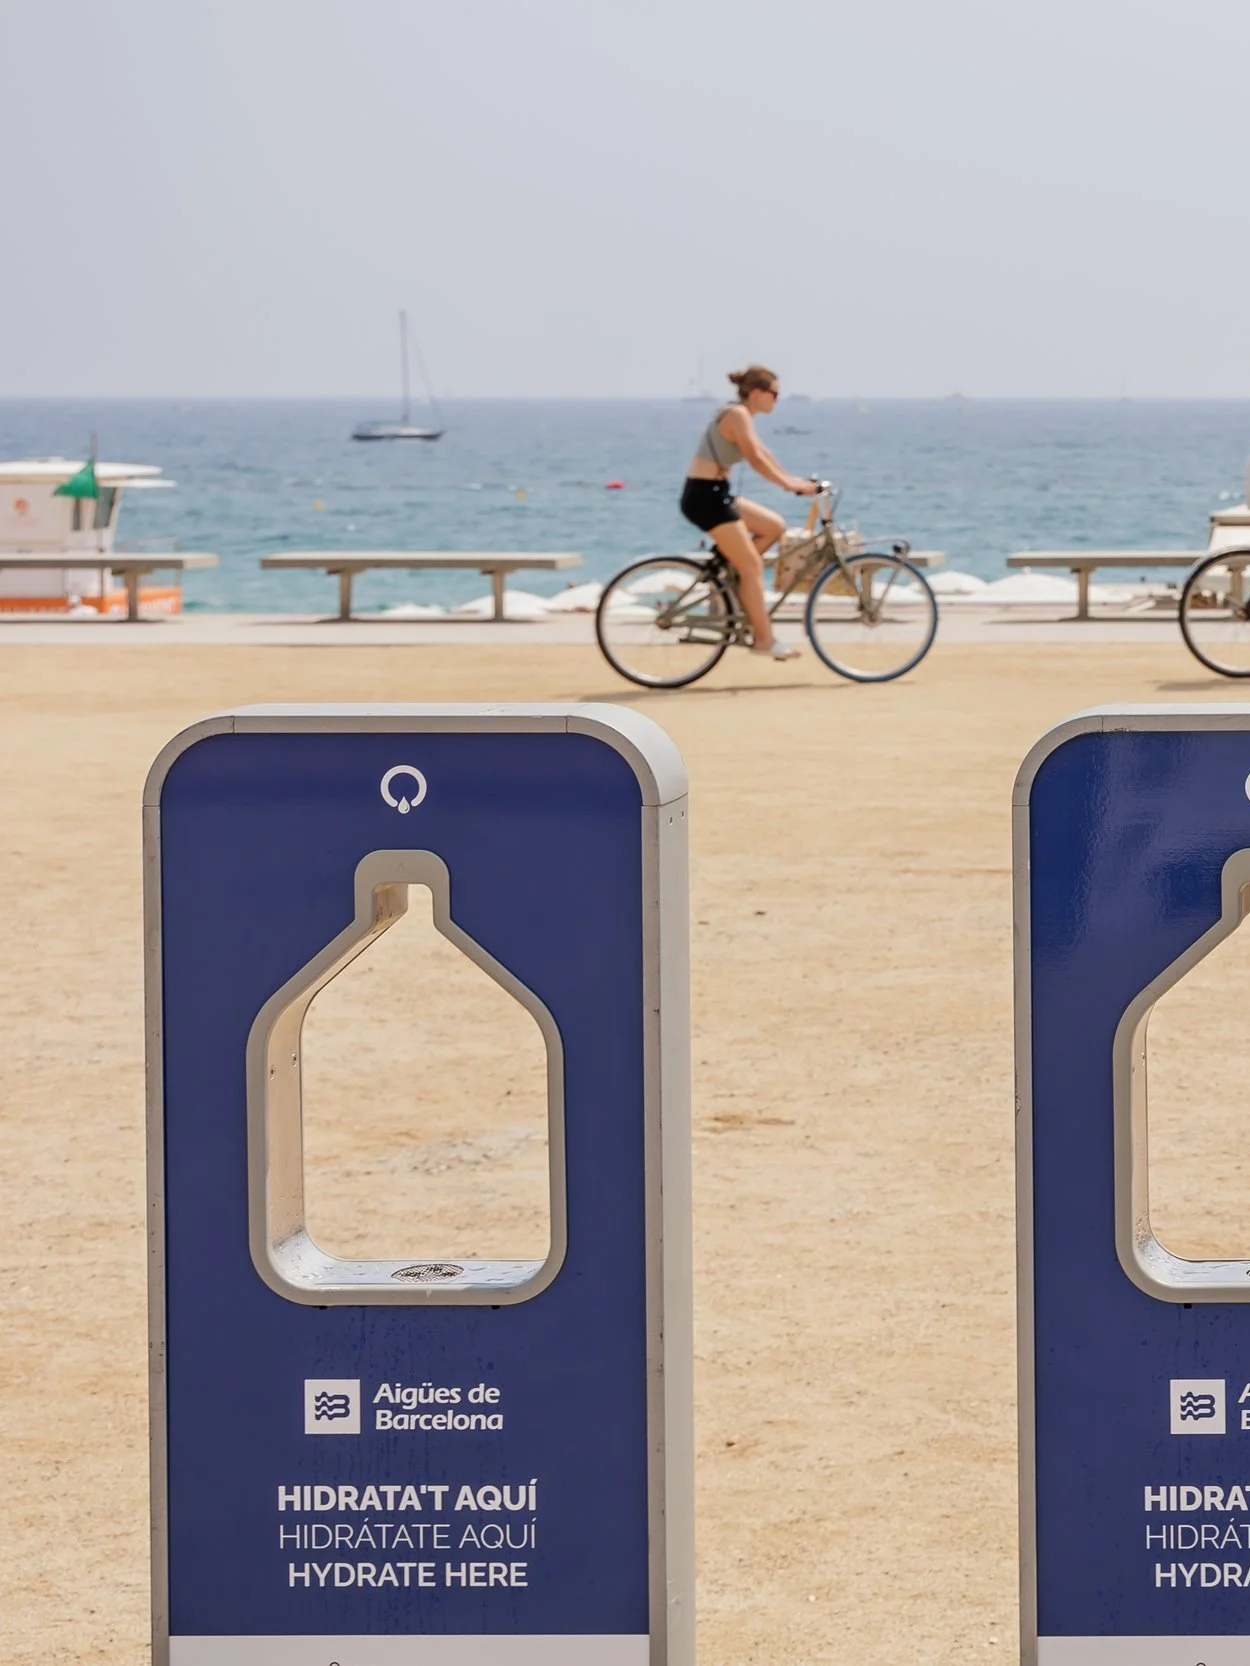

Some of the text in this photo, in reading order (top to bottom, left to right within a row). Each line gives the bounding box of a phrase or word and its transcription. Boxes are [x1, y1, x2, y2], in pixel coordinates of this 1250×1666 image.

[373, 1383, 501, 1411] Aigües de
[375, 1409, 504, 1431] Barcelona
[277, 1478, 538, 1512] HIDRATA'T AQUÍ
[279, 1517, 537, 1550] HIDRÁTATE AQUÍ
[288, 1562, 529, 1588] HYDRATE HERE
